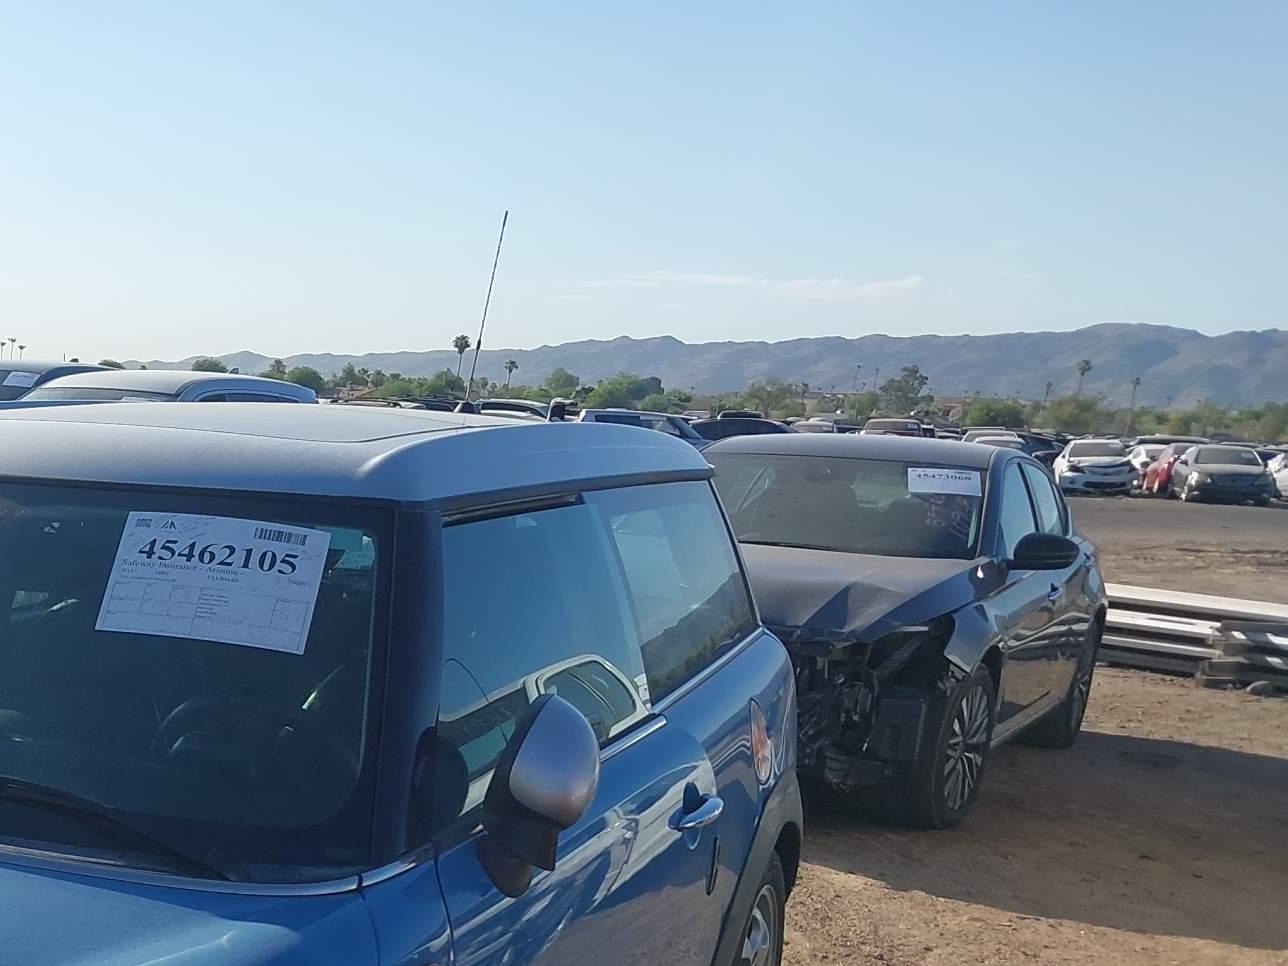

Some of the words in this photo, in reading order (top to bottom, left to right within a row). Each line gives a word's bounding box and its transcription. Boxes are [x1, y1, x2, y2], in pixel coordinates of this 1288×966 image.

[122, 559, 155, 569] Safeway
[158, 562, 198, 572] Insurance
[137, 537, 300, 575] 45462105
